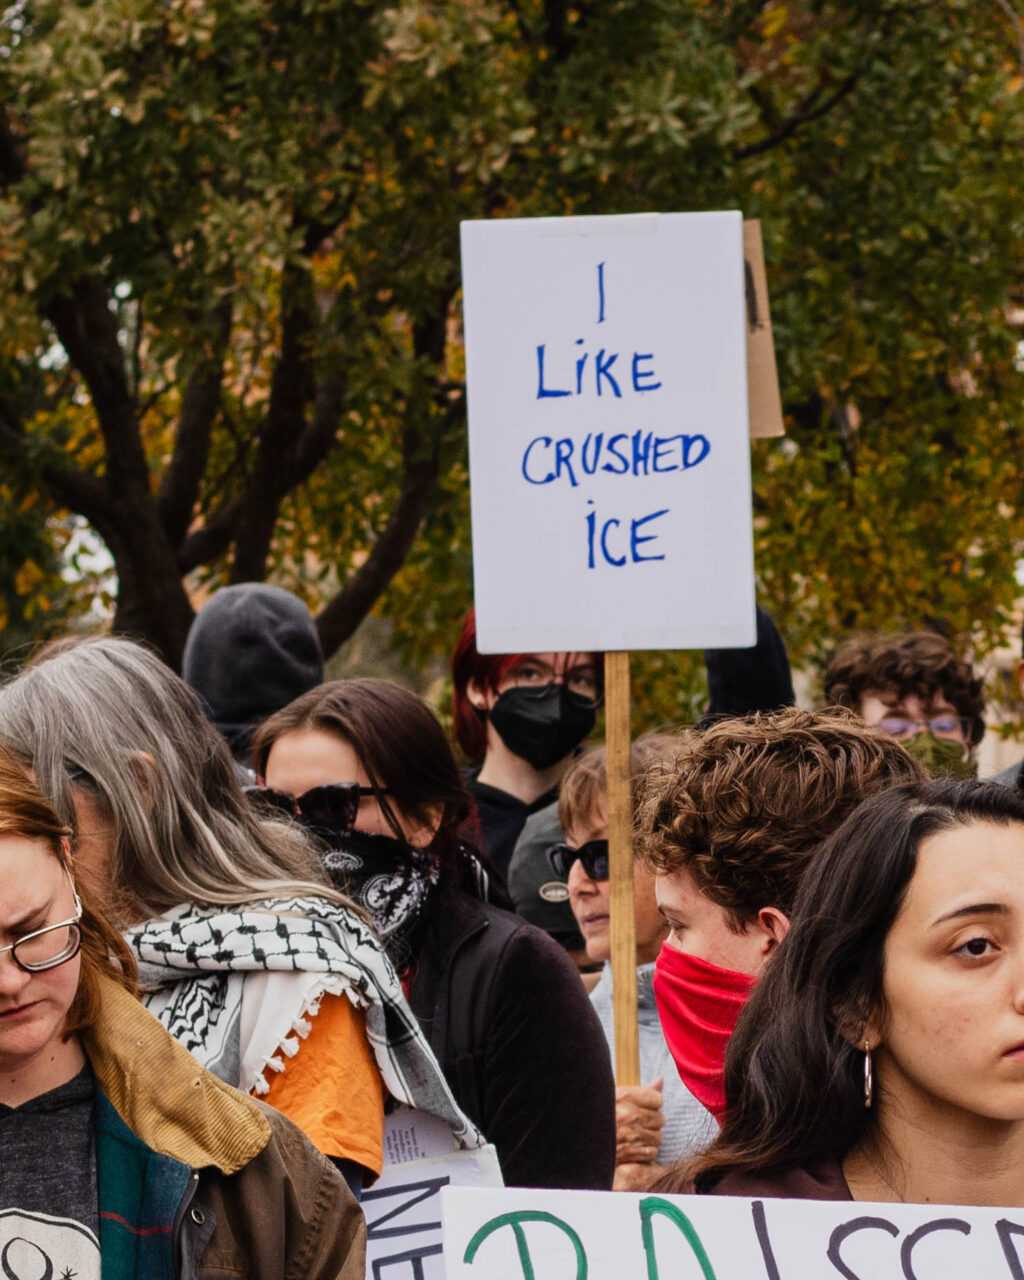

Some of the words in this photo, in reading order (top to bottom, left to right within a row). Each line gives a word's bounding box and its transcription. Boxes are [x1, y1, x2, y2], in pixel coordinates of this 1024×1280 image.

[595, 261, 606, 324] I
[535, 339, 662, 400] LiKE
[521, 429, 711, 487] CRUSHED
[584, 499, 670, 569] iCE
